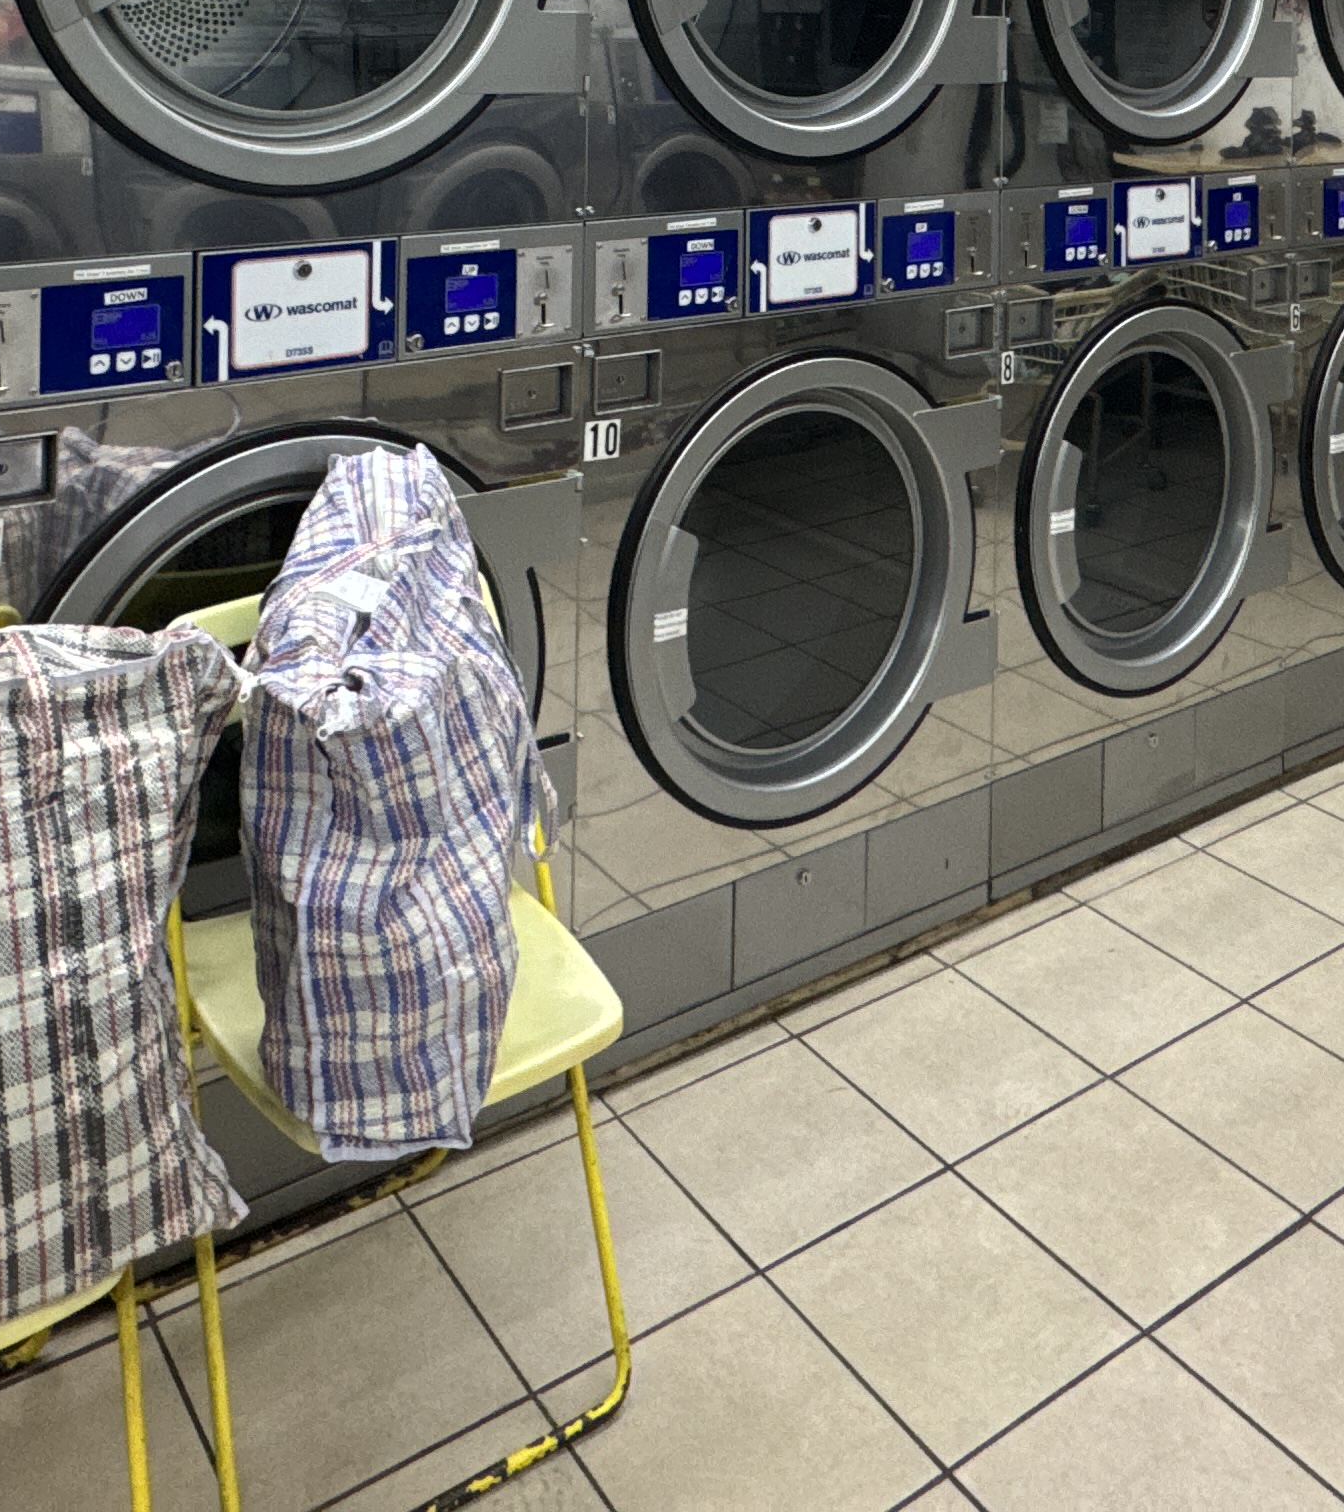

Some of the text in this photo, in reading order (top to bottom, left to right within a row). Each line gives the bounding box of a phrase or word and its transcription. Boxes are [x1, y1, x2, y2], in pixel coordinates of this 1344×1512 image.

[804, 248, 850, 262] wascomat
[464, 265, 475, 275] UP
[110, 290, 145, 303] DOWN
[287, 297, 357, 316] wascomat
[1293, 306, 1299, 329] 6
[1004, 354, 1012, 381] 8
[590, 422, 617, 457] 10
